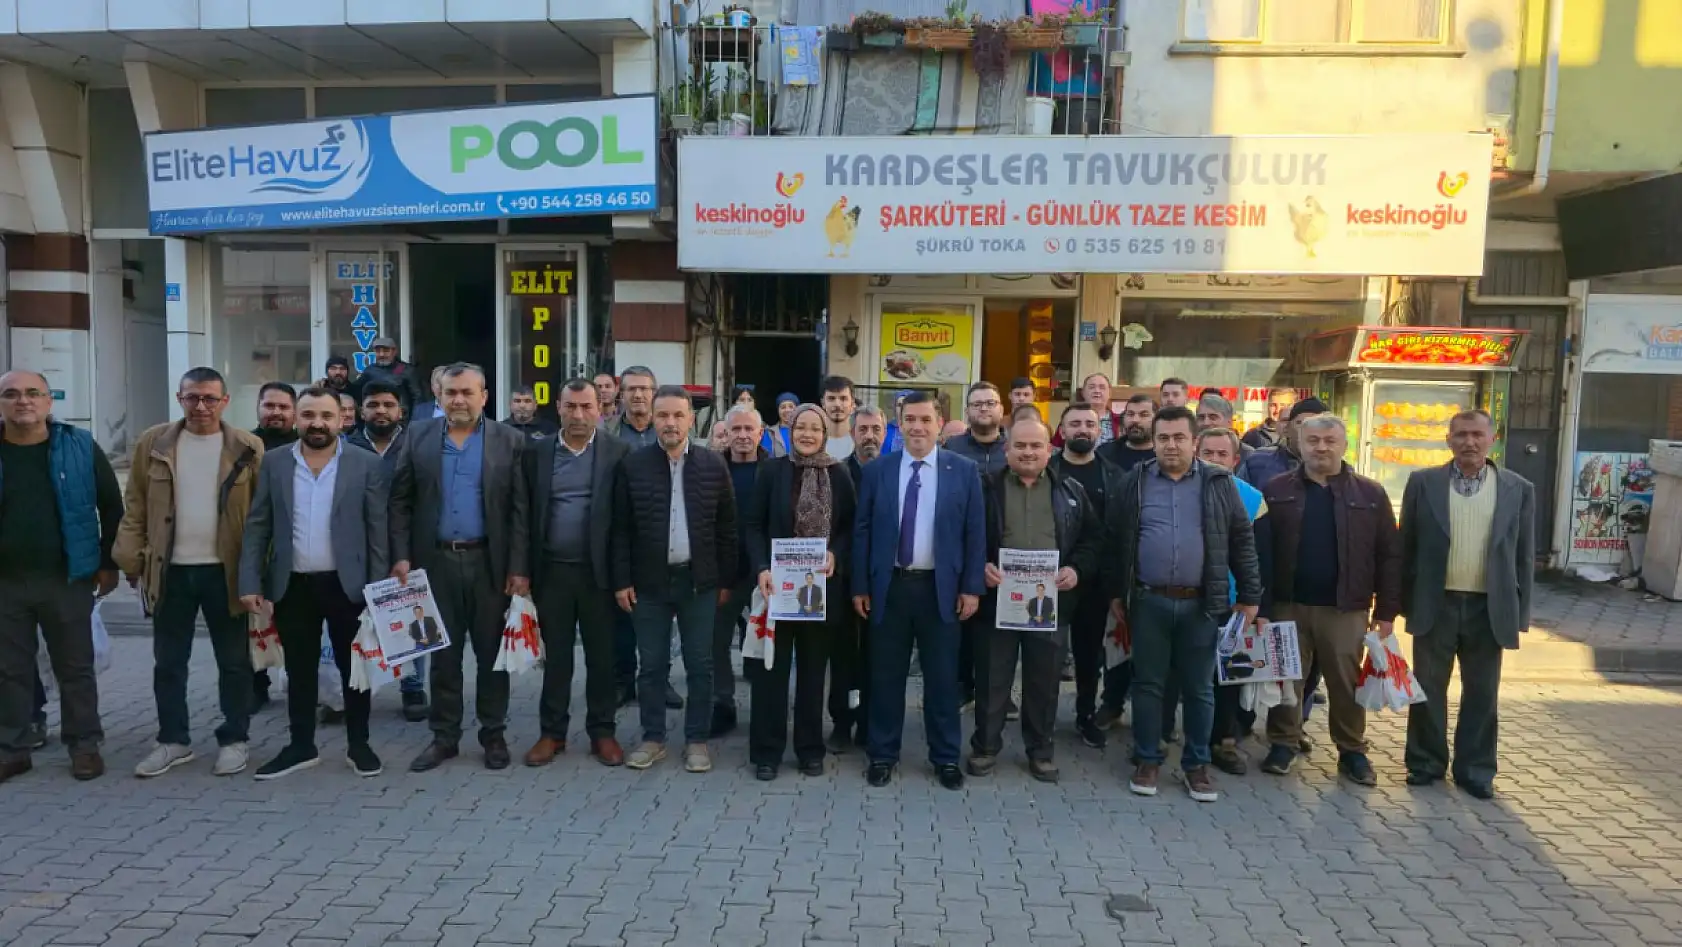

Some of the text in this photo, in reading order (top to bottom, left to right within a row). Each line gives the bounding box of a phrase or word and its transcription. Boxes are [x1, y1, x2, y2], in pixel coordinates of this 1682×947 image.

[449, 115, 644, 174] POOL
[825, 152, 1328, 196] KARDEŞLER TAVUKÇULUK
[281, 200, 486, 222] www.elitehavuzsistemleri.com.tr
[509, 191, 651, 210] +90 544 258 46 50
[695, 202, 806, 228] keskinoğlu
[880, 198, 1005, 232] ŞARKÜTERİ
[1026, 199, 1120, 227] GÜNLÜK
[1129, 204, 1185, 226] TAZE
[1193, 199, 1267, 227] KESİM
[1346, 203, 1467, 230] keskinoğlu
[916, 236, 1226, 255] ŞÜKRÜ TOKA 0 535 625 19 81
[337, 259, 394, 280] ELİT
[510, 264, 573, 294] ELİT
[351, 283, 377, 378] HAVU
[898, 327, 951, 343] Banvit
